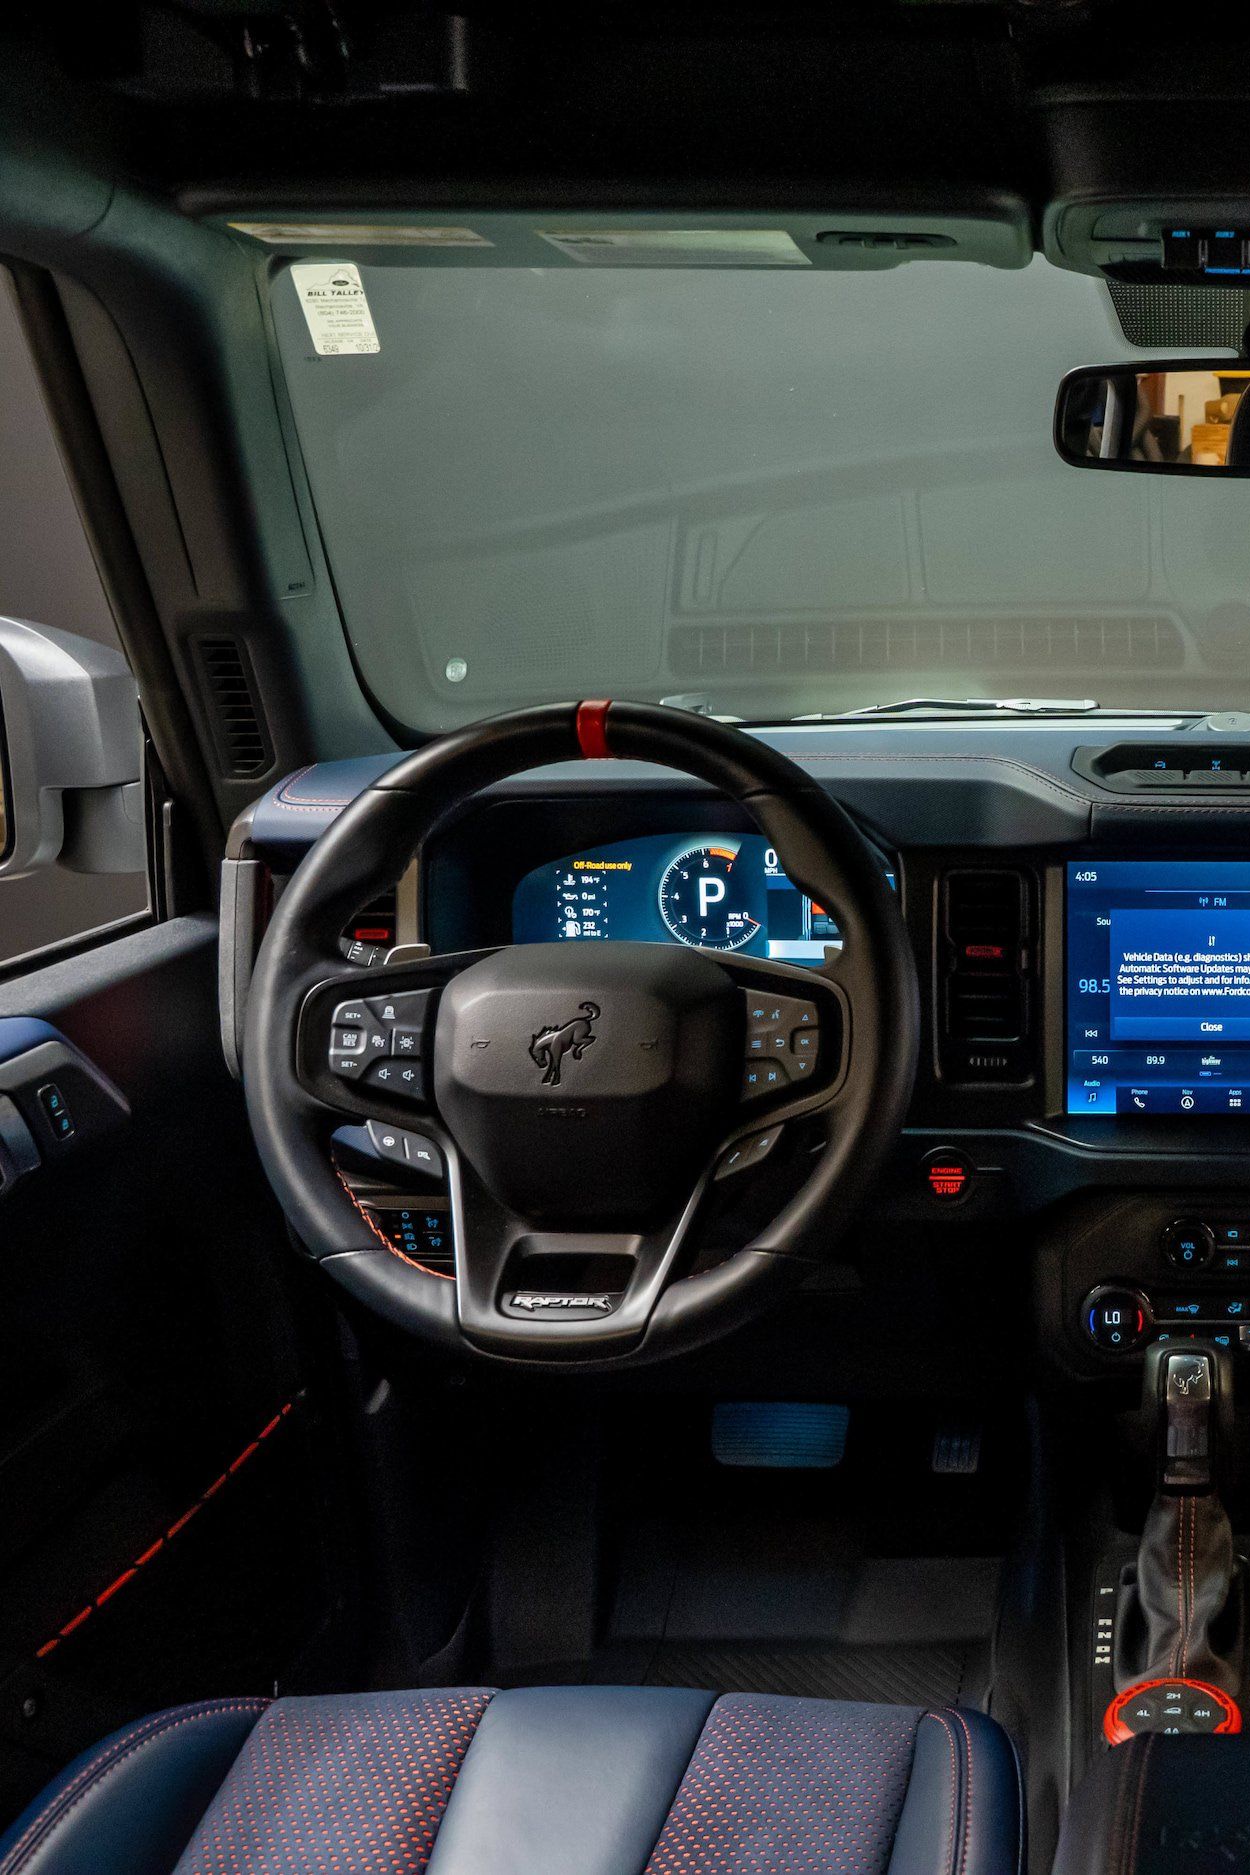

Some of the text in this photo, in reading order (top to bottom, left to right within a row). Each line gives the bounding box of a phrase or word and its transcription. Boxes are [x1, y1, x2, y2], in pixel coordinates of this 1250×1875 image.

[764, 848, 778, 868] 0
[573, 861, 632, 871] Off-Road use only
[703, 861, 709, 869] 6
[682, 871, 689, 880] 5
[1075, 871, 1098, 882] 4:05
[698, 877, 726, 917] P
[1214, 898, 1227, 907] FM
[681, 915, 688, 923] 3
[582, 921, 596, 930] 232
[701, 928, 707, 937] 2
[1123, 953, 1153, 962] Vehicle
[1153, 953, 1173, 962] Data
[1174, 952, 1192, 963] (e.g.
[1193, 952, 1242, 964] diagnostics)
[1119, 964, 1161, 973] Automatic
[1162, 964, 1200, 973] Software
[1200, 964, 1234, 975] Updates
[1117, 975, 1133, 985] See
[1133, 975, 1167, 986] Settings
[1168, 976, 1177, 985] to
[1177, 975, 1203, 986] adjust
[1204, 975, 1220, 985] and
[1221, 975, 1233, 985] for
[1079, 979, 1111, 993] 98.5
[1119, 986, 1133, 995] the
[1134, 986, 1162, 997] privacy
[1163, 986, 1189, 995] notice
[1200, 1022, 1223, 1032] Close
[1091, 1055, 1109, 1065] 540
[1146, 1055, 1165, 1065] 89.9
[1083, 1079, 1101, 1087] Audio
[1131, 1088, 1149, 1096] Phone
[1181, 1088, 1194, 1096] Nav
[1228, 1088, 1242, 1097] Apps
[1180, 1242, 1196, 1250] VOL
[512, 1295, 612, 1311] RAPTOR
[1166, 1692, 1181, 1700] 2H
[1136, 1709, 1151, 1717] 4L
[1194, 1709, 1211, 1717] 4H
